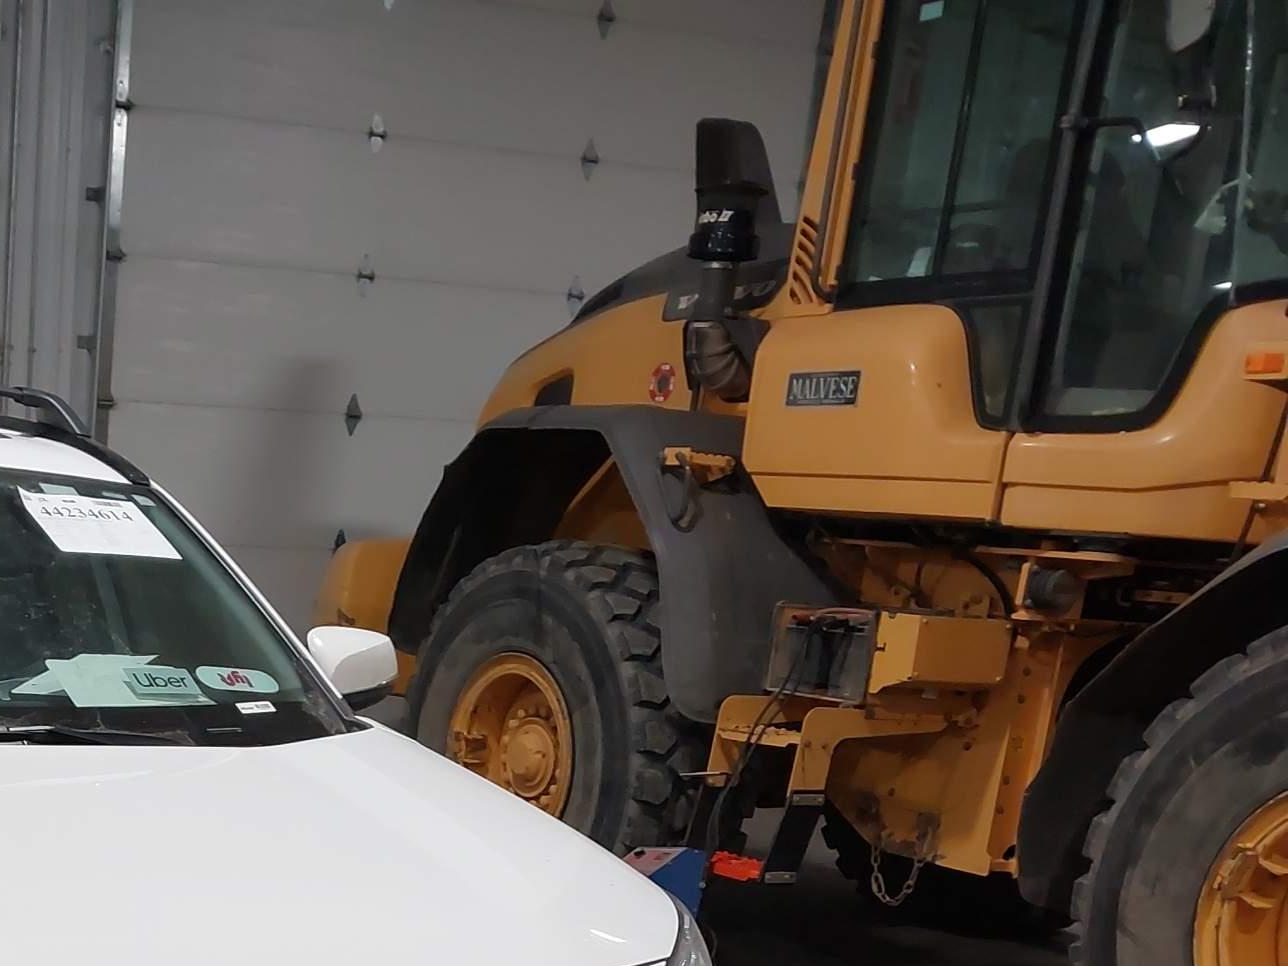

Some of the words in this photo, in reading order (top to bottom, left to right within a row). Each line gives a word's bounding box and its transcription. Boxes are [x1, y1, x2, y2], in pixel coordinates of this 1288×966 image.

[678, 279, 777, 309] VVO
[789, 376, 857, 400] MALVESE
[40, 506, 134, 521] 44234614
[132, 673, 188, 688] Uber
[217, 671, 254, 688] lyft
